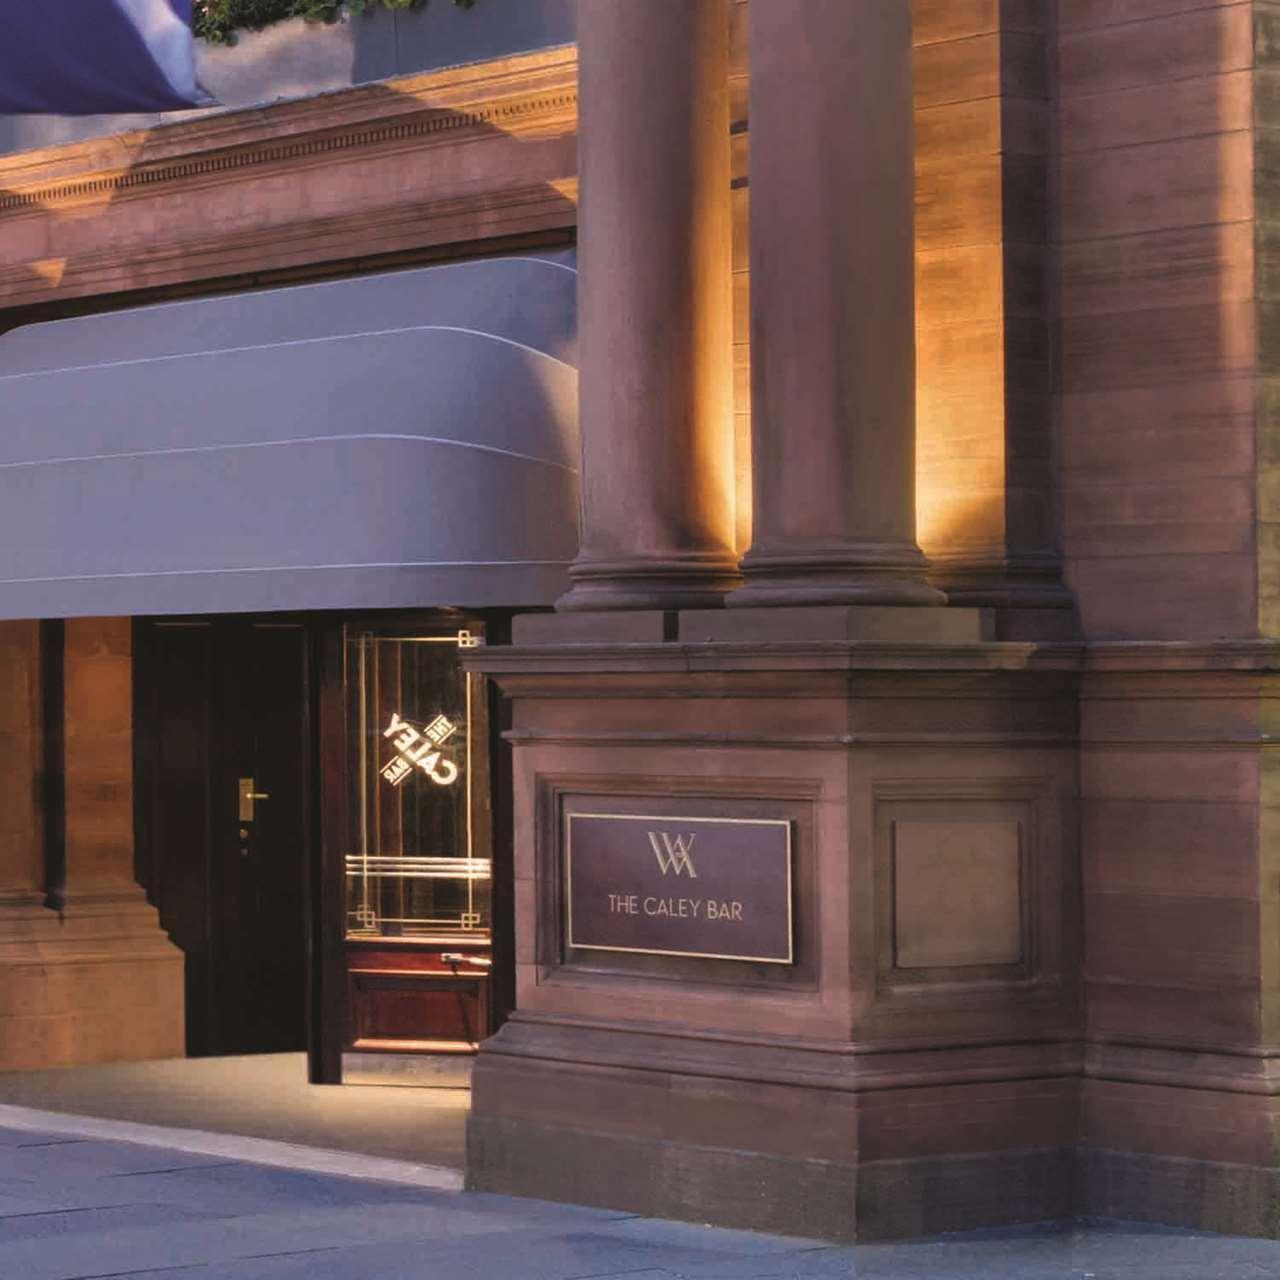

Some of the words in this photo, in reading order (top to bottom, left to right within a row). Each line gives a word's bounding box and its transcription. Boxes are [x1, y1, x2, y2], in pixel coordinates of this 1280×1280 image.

[608, 894, 639, 914] THE
[643, 897, 701, 918] CALEY
[707, 900, 743, 920] BAR
